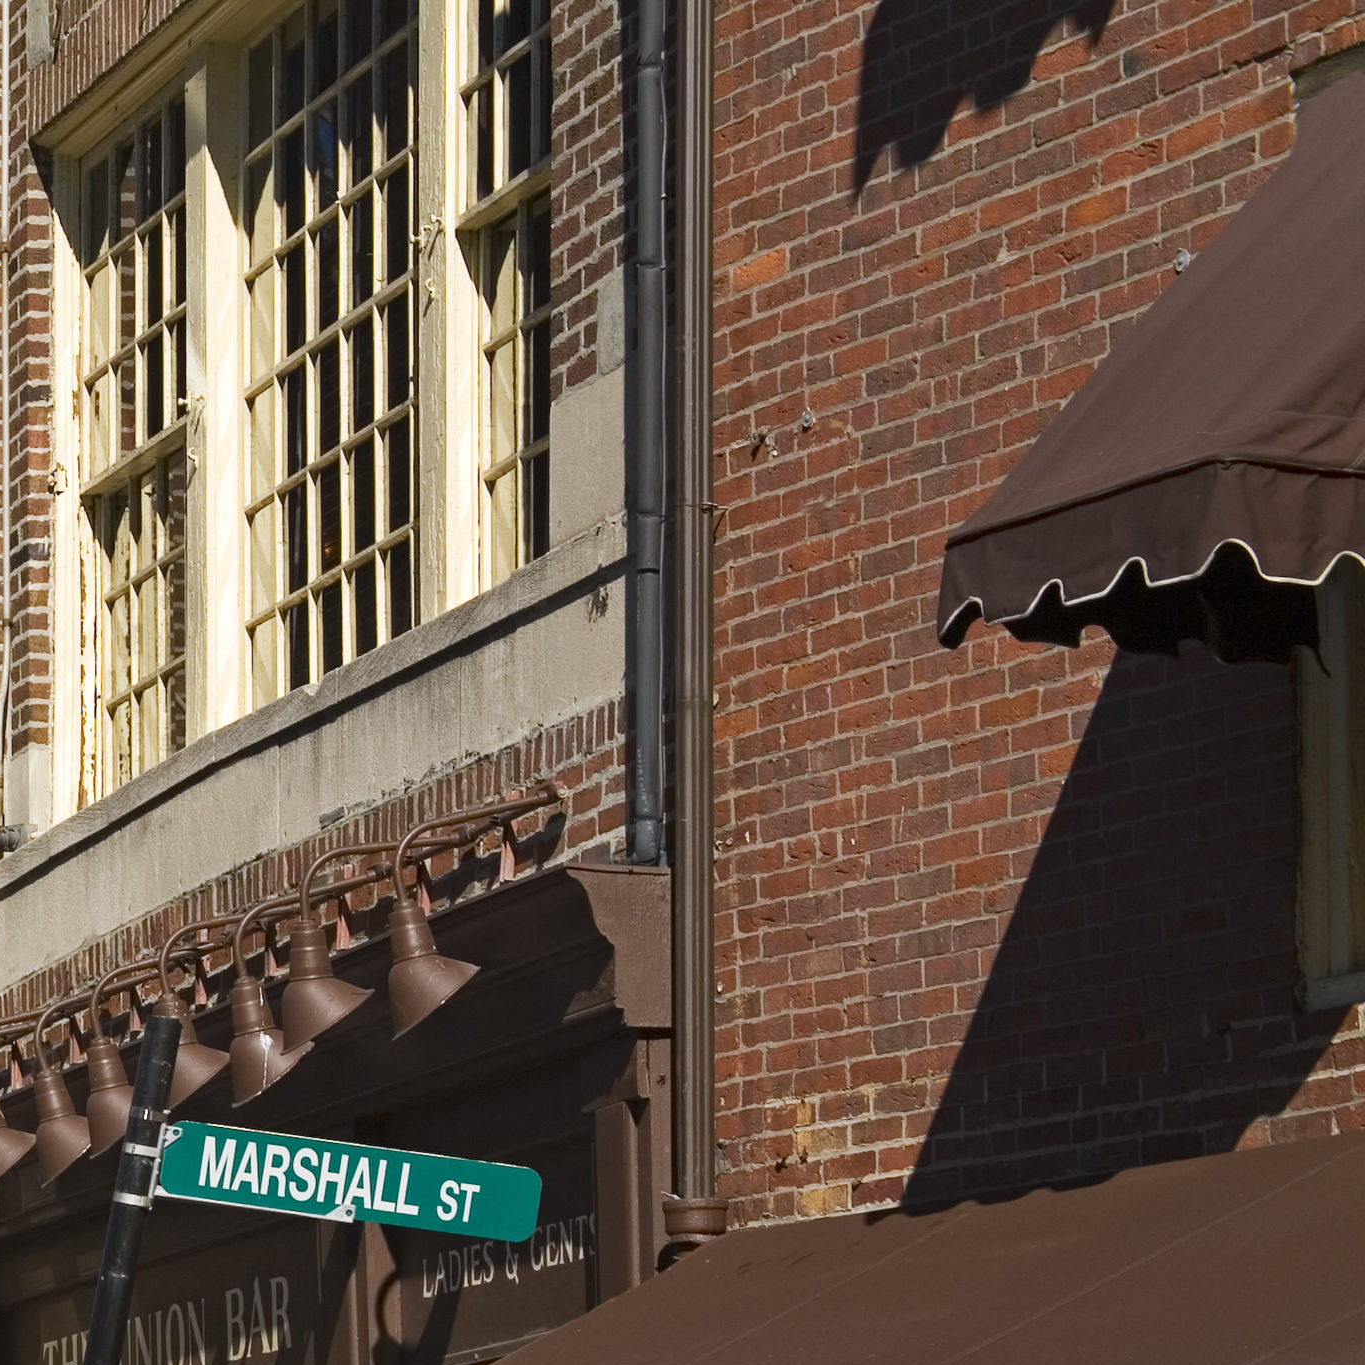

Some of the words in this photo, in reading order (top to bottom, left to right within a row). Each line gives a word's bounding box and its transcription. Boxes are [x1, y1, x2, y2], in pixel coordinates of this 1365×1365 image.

[198, 1136, 419, 1215] MARSHALL
[436, 1180, 480, 1222] ST
[422, 1237, 495, 1298] LADIES
[505, 1240, 520, 1284] &
[225, 1275, 292, 1362] BAR
